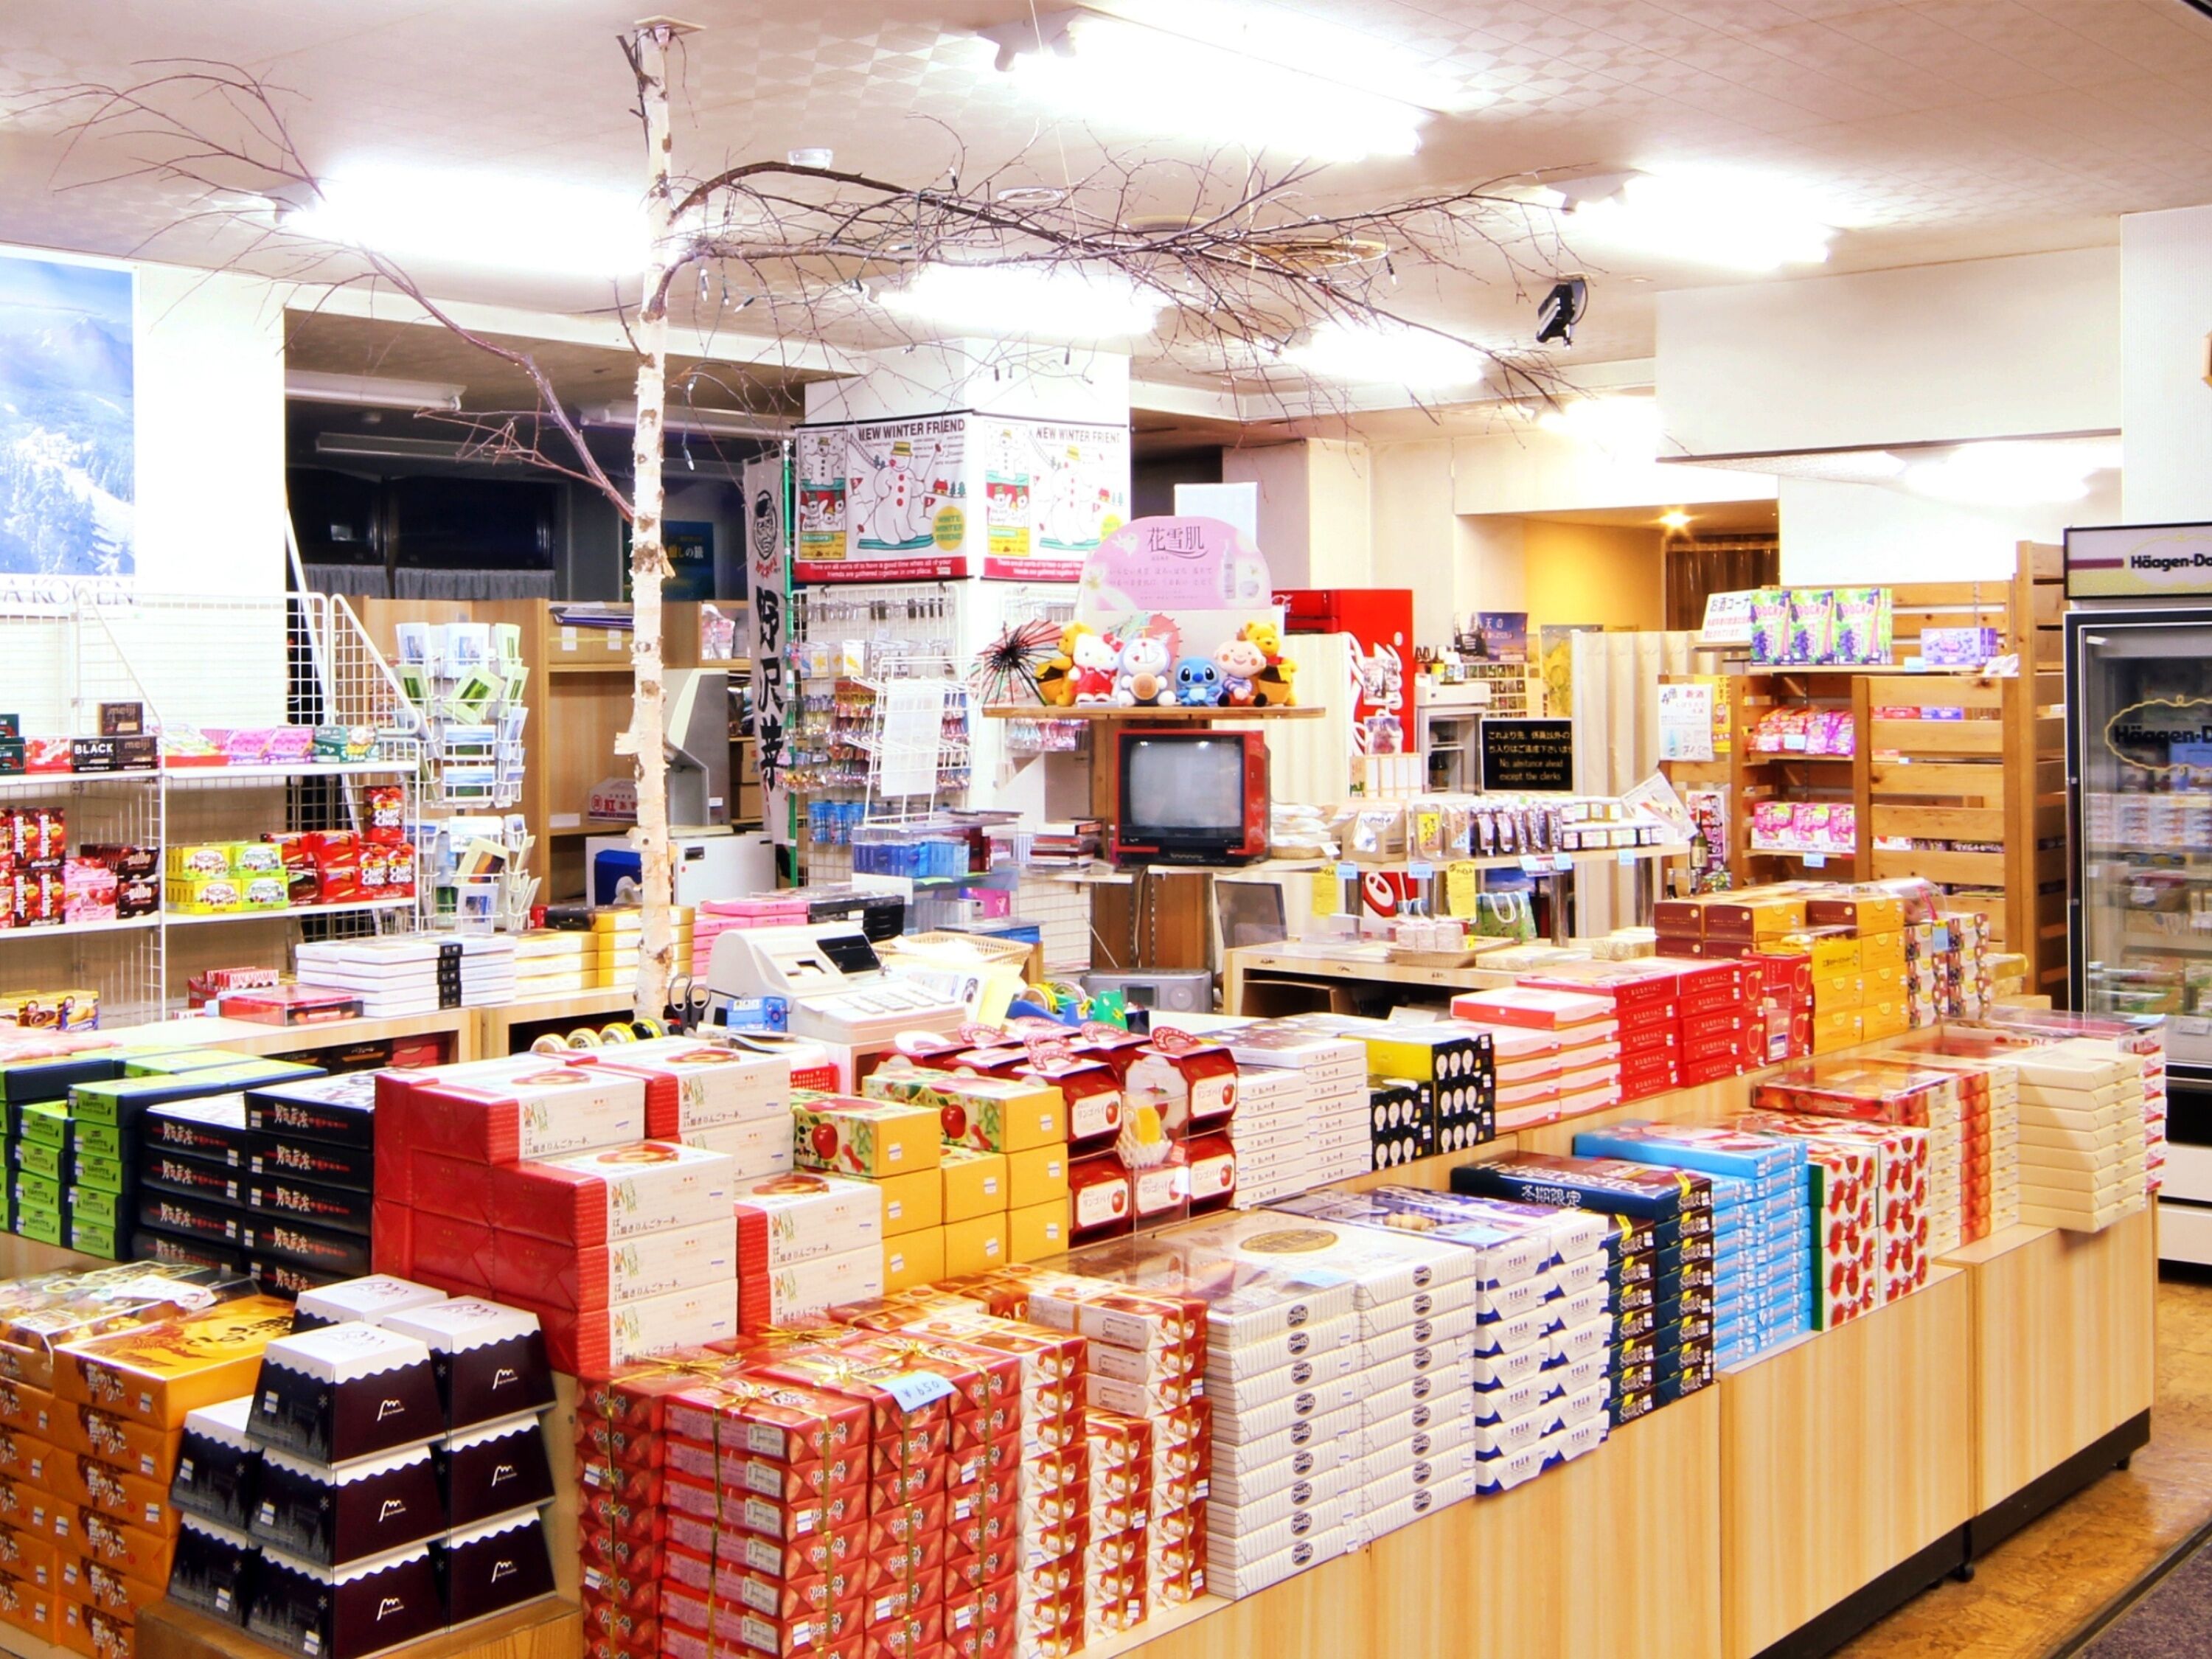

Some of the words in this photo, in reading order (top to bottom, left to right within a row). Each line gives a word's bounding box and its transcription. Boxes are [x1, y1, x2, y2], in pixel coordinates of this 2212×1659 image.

[883, 422, 923, 438] WINTER
[926, 419, 965, 435] FRIEND
[1035, 427, 1056, 440] NEW
[1058, 428, 1090, 442] WINTER
[1147, 526, 1205, 552] 花雪肌
[1711, 595, 1751, 612] お酒コーナ
[756, 586, 785, 791] 野沢菜
[74, 743, 114, 755] BLACK
[124, 739, 150, 751] meiji
[374, 817, 400, 827] Chop
[361, 875, 384, 886] Chop
[389, 874, 411, 883] Chop
[232, 970, 277, 984] MACADAMIA
[1522, 1184, 1582, 1207] 冬期限定
